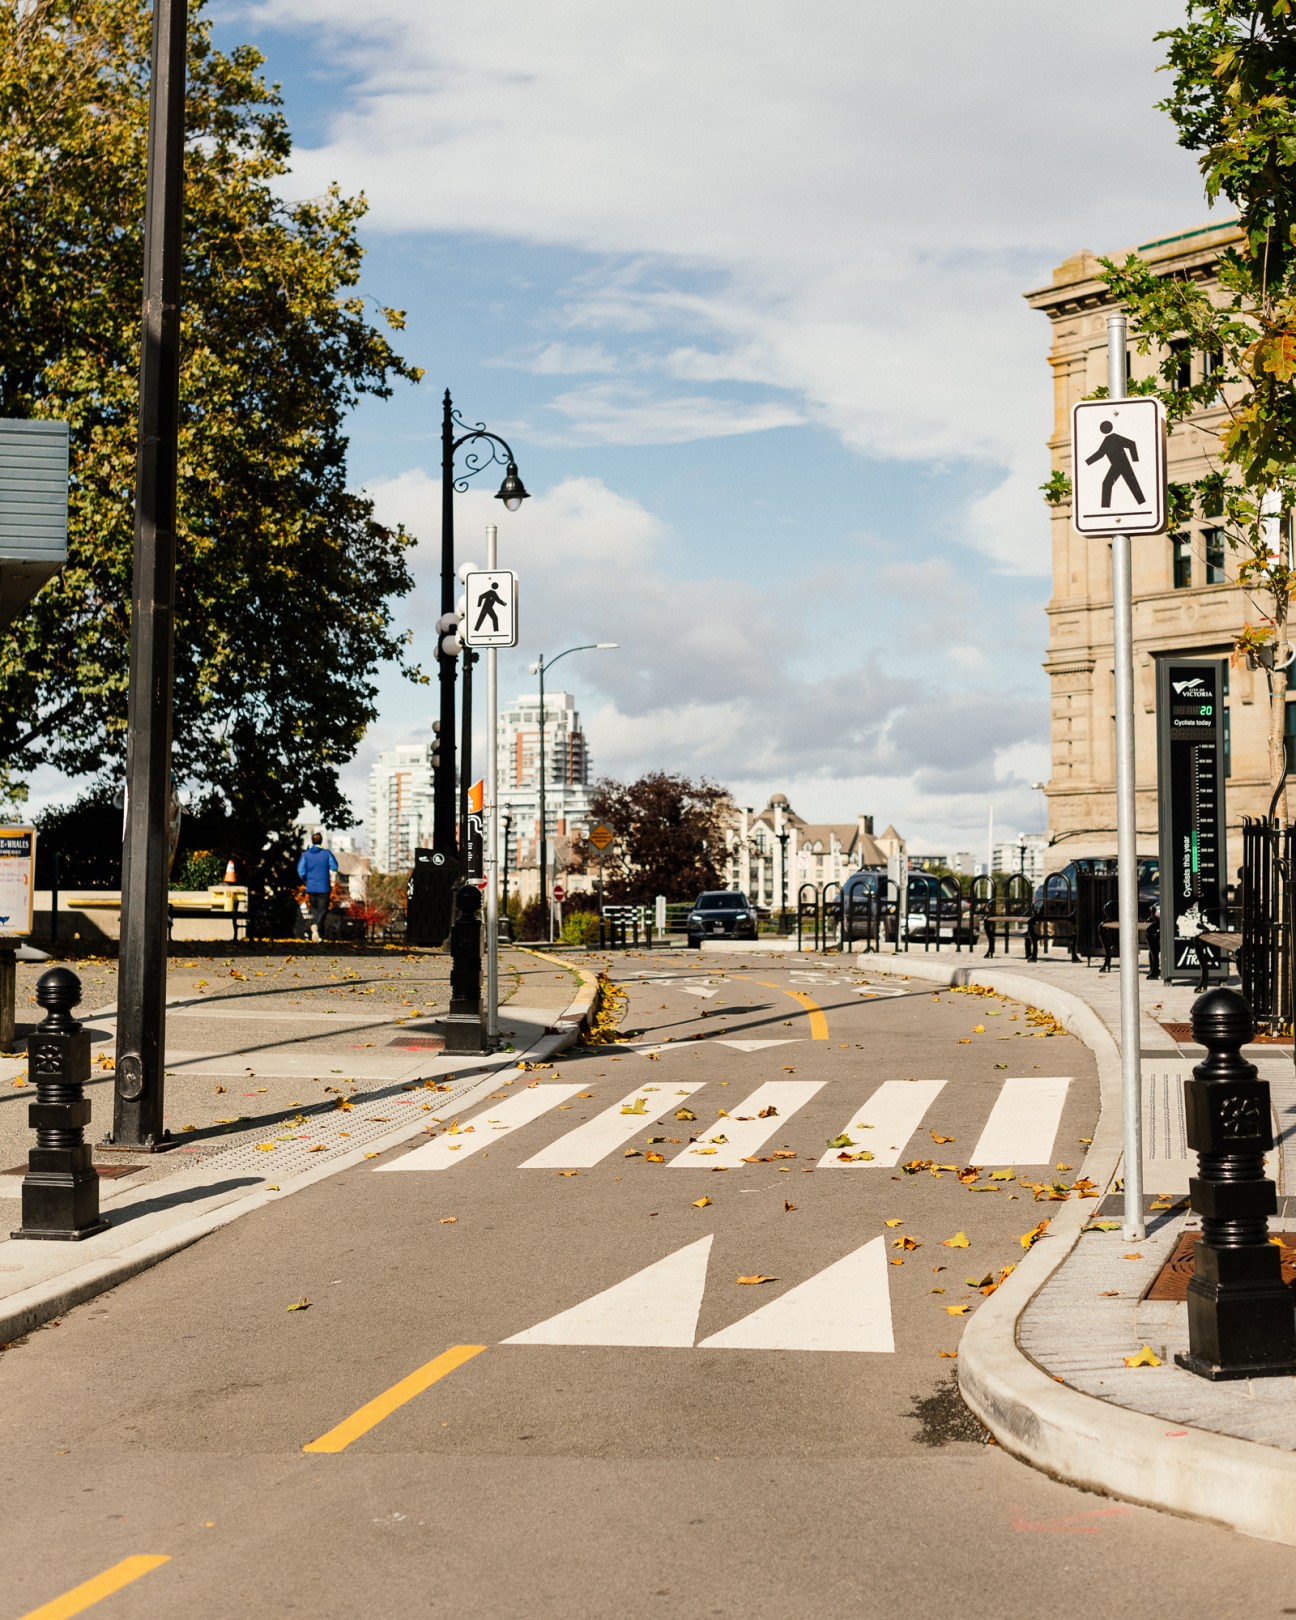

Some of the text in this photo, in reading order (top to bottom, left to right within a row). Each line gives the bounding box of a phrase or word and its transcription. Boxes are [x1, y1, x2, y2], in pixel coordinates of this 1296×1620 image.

[1200, 706, 1212, 716] 20
[8, 840, 29, 848] WHALES
[1183, 868, 1192, 897] Cyclists
